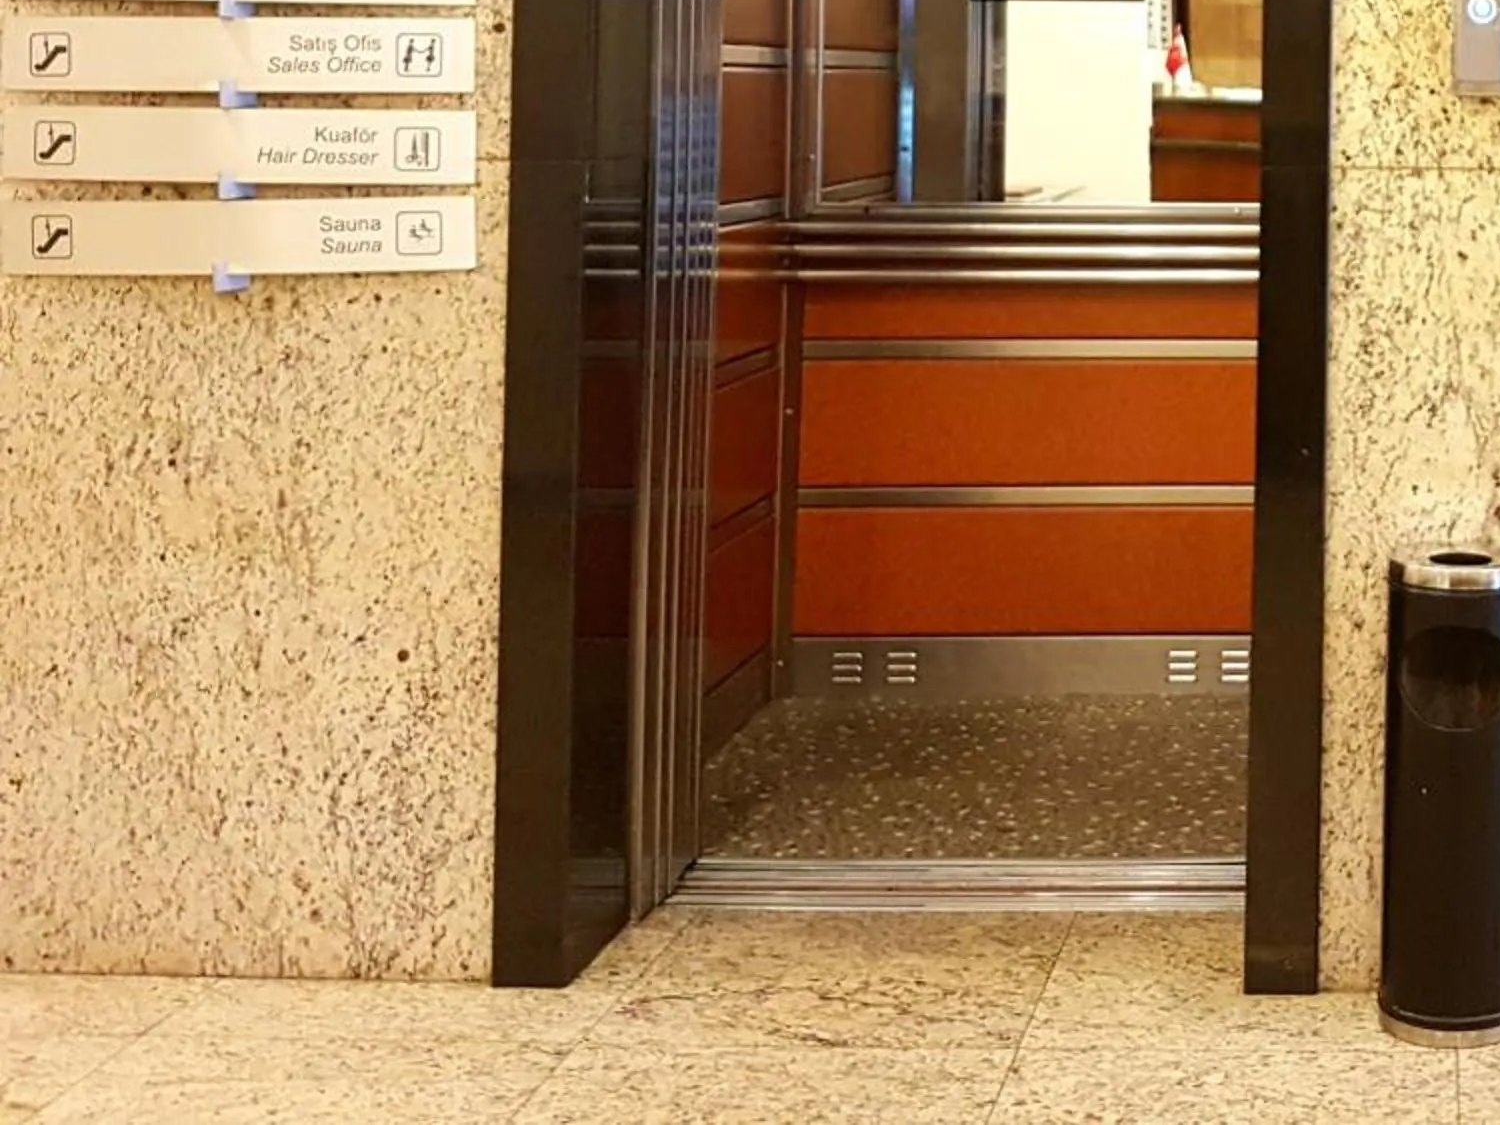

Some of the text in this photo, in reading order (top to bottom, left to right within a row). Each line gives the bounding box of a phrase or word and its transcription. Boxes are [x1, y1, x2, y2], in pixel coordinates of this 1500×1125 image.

[267, 56, 381, 73] Sales Office
[315, 127, 377, 143] Kuaför
[257, 147, 379, 165] Hair Dresser
[320, 216, 381, 232] Sauna
[321, 237, 382, 254] Sauna
